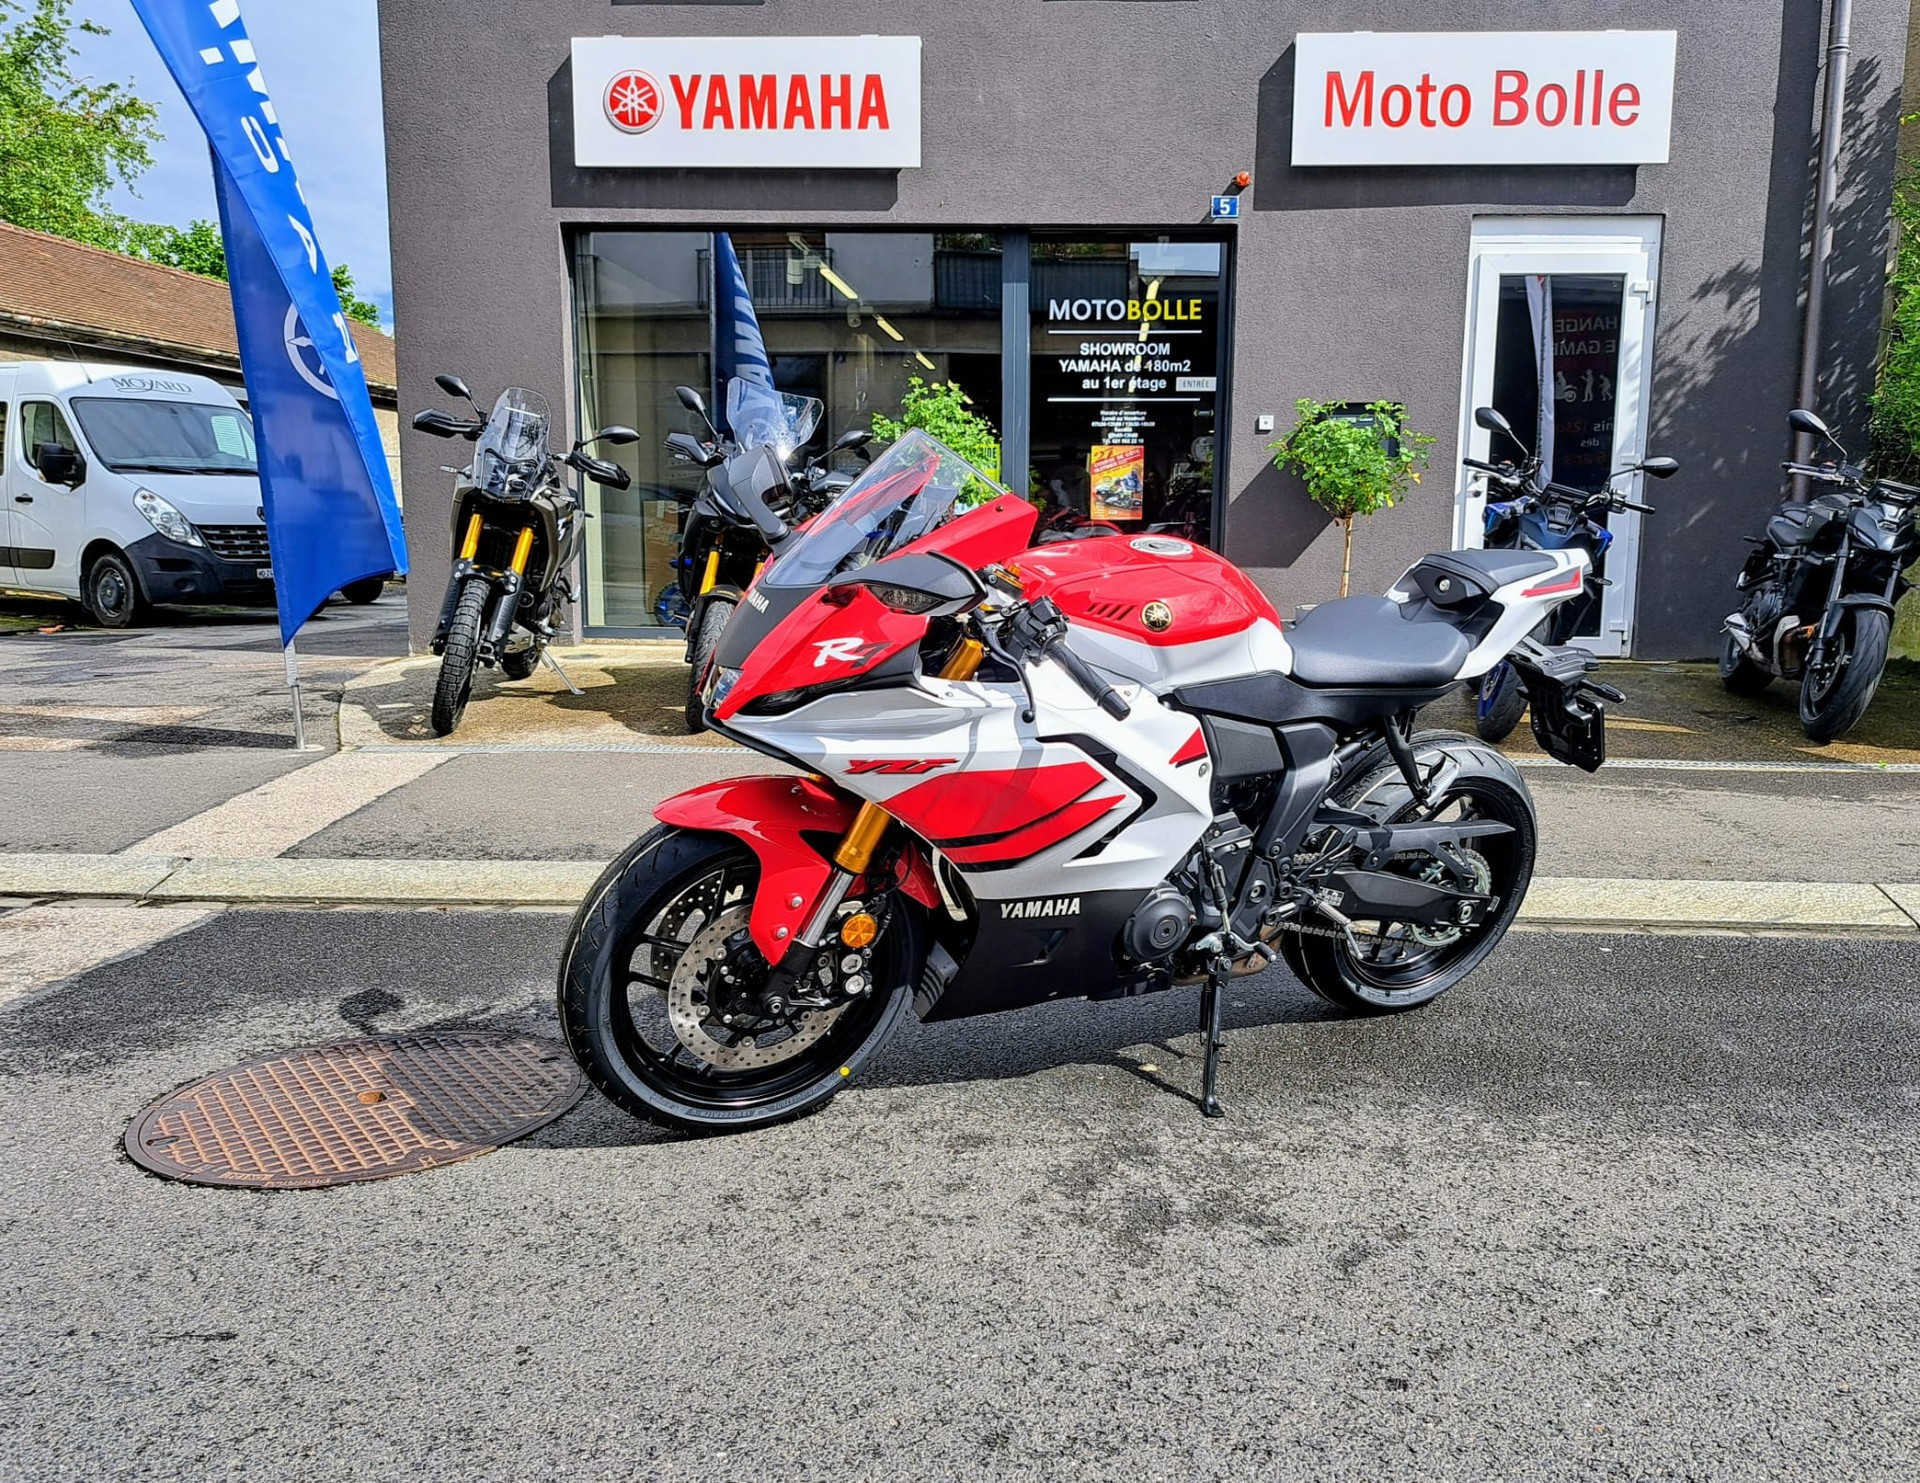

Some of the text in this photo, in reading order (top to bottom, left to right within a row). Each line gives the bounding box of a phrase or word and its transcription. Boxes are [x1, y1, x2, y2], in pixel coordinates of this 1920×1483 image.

[668, 74, 890, 130] YAMAHA
[1323, 69, 1641, 128] Moto Bolle
[1220, 198, 1231, 215] 5
[1049, 298, 1202, 321] MOTOBOLLE
[1080, 342, 1170, 356] SHOWROOM
[1059, 359, 1191, 372] YAMAHA de 180m2
[111, 377, 193, 395] MOYARD
[1082, 376, 1167, 391] au 1er étage
[747, 587, 770, 614] MAHA
[1000, 897, 1081, 918] YAMAHA
